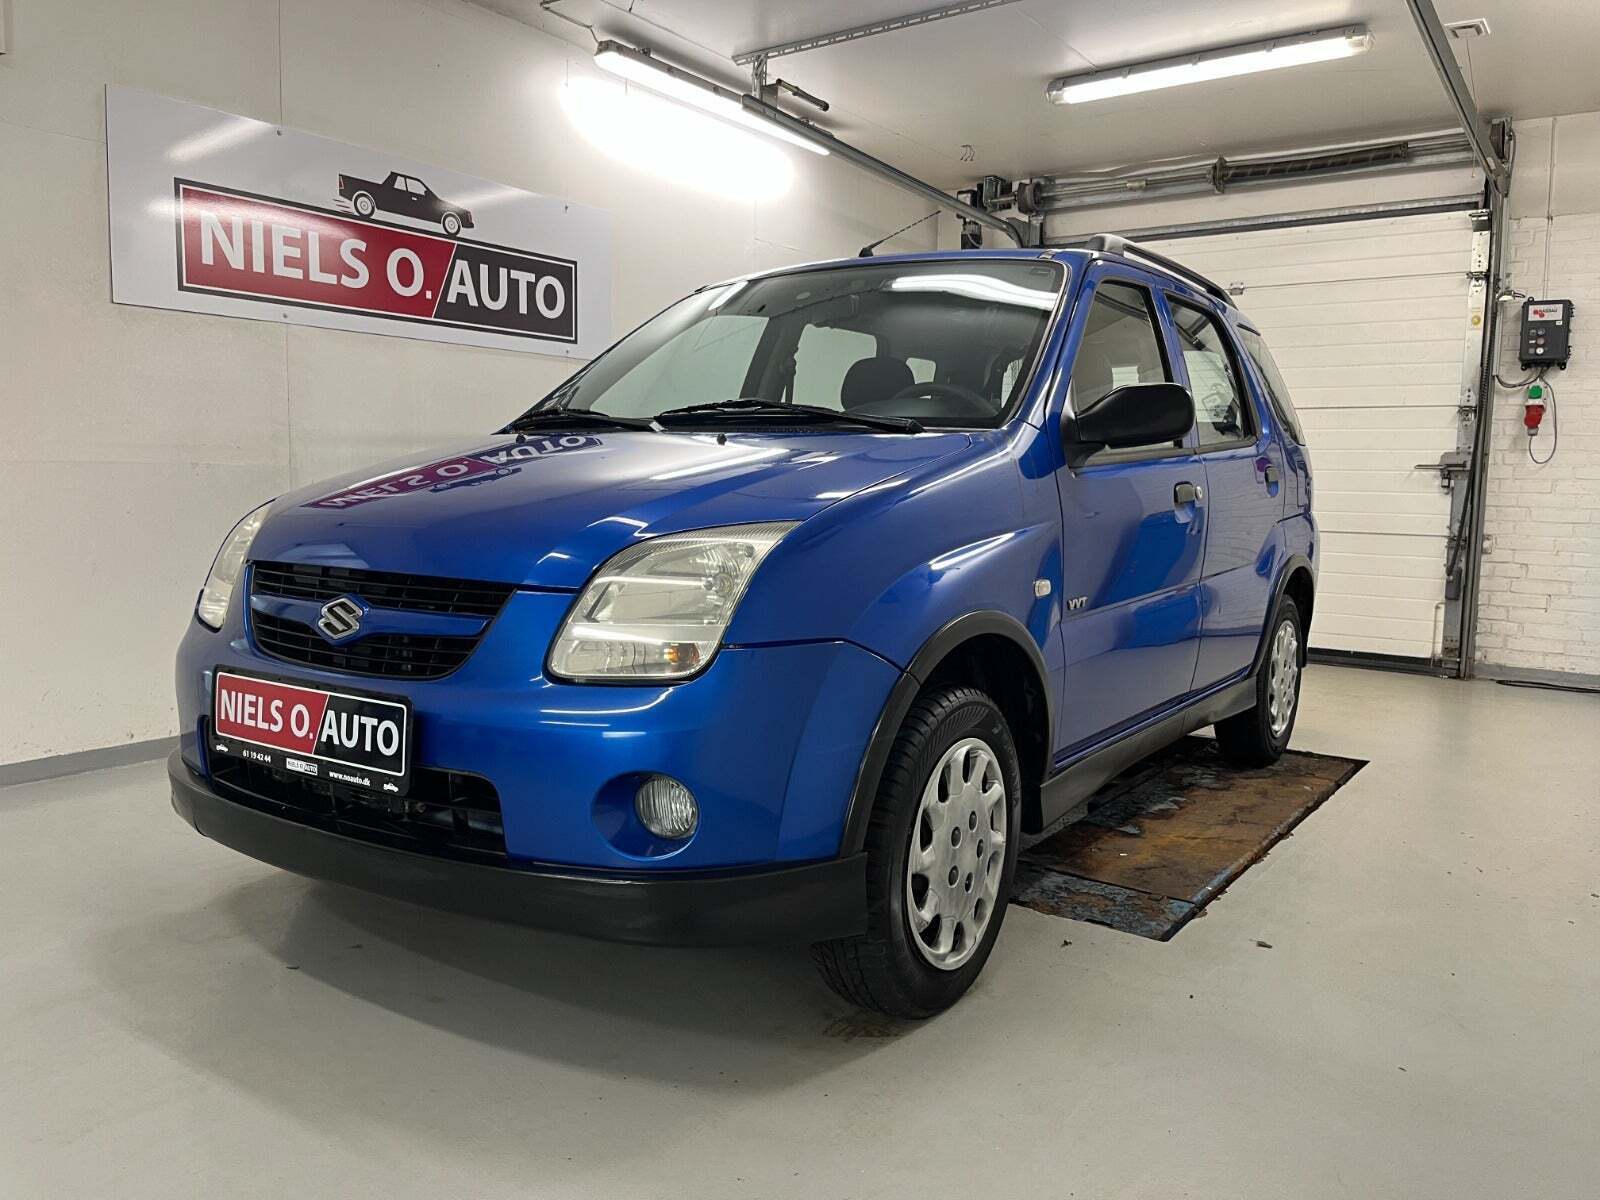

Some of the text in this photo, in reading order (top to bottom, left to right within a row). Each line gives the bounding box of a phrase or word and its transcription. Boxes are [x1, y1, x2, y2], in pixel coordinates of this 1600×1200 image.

[200, 210, 565, 320] NIELS O. AUTO
[1067, 596, 1088, 610] VVT
[220, 689, 400, 757] NIELS O. AUTO
